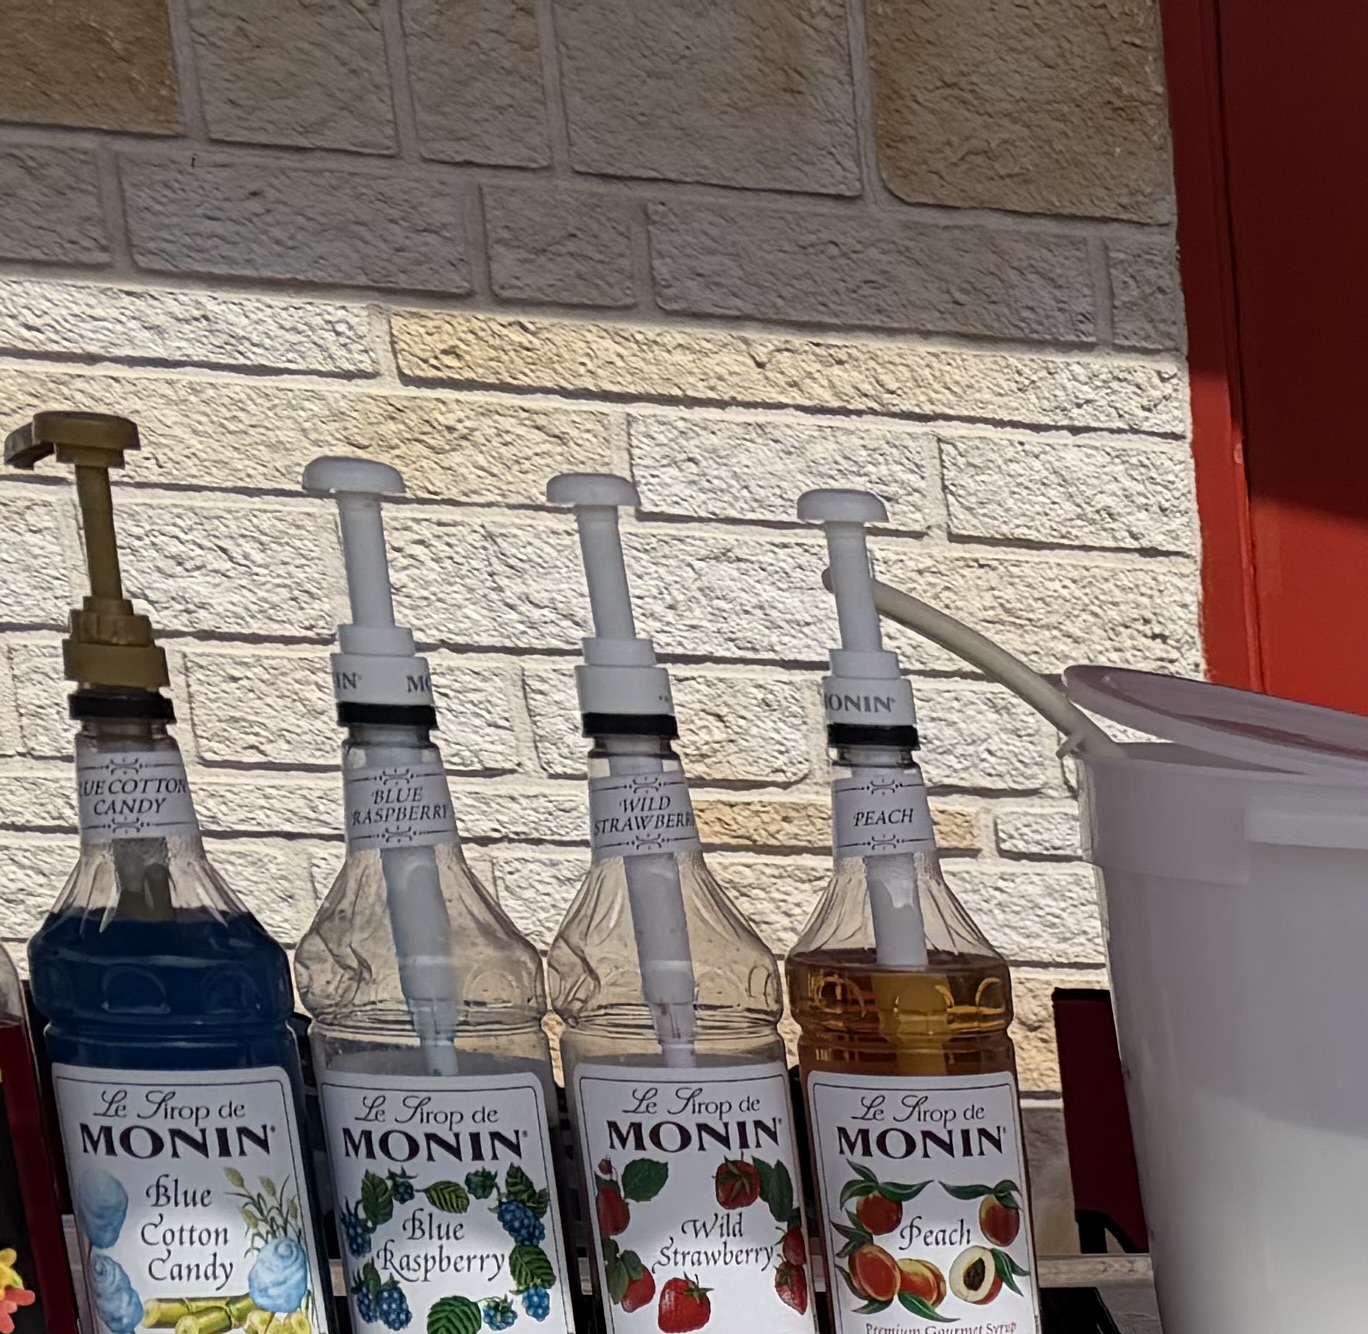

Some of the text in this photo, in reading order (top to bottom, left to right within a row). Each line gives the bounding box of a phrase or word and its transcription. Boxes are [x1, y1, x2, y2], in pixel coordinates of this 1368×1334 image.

[108, 778, 187, 795] COTTON
[372, 786, 423, 805] BLUE
[94, 797, 167, 815] CANDY
[619, 795, 671, 813] WILD
[854, 808, 914, 827] PEACH
[93, 1089, 246, 1127] Le Sirop de
[354, 1095, 499, 1132] Le Sirop de
[622, 1087, 760, 1120] Le Sirop de
[851, 1095, 985, 1128] Le Sirop de
[79, 1123, 272, 1159] MONIN
[341, 1127, 523, 1162] MONIN
[606, 1117, 780, 1153] MONIN
[836, 1126, 1003, 1159] MONIN
[145, 1173, 212, 1208] Blue
[140, 1213, 229, 1247] Cotton
[402, 1207, 465, 1241] Blue
[681, 1212, 744, 1239] Wild
[899, 1216, 972, 1251] Peach
[148, 1249, 234, 1291] Candy
[376, 1239, 505, 1283] Raspberry
[651, 1236, 774, 1274] Strawberry
